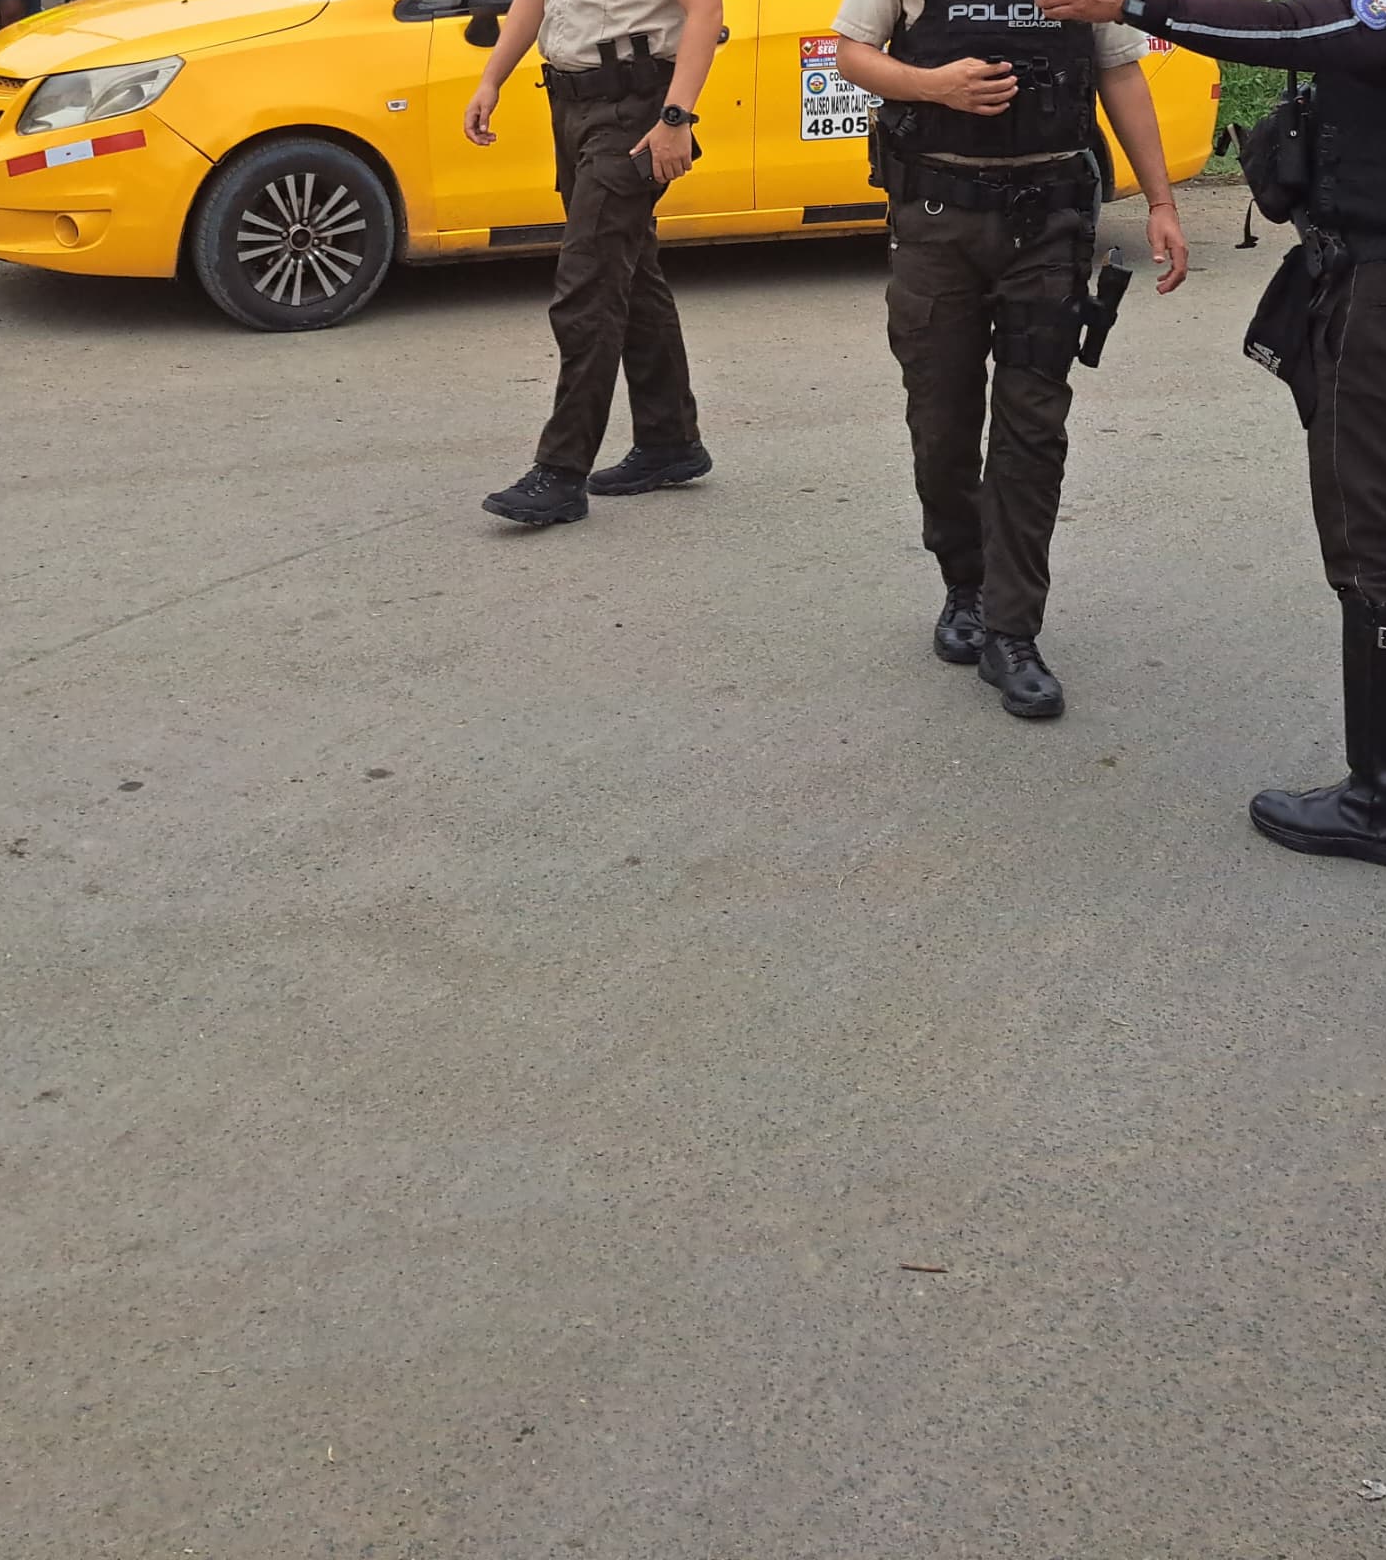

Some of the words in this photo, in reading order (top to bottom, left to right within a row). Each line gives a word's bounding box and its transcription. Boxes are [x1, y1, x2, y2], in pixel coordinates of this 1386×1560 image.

[1008, 20, 1062, 28] ECUADOR
[835, 82, 855, 93] TAXIS
[831, 94, 850, 115] MAYOR
